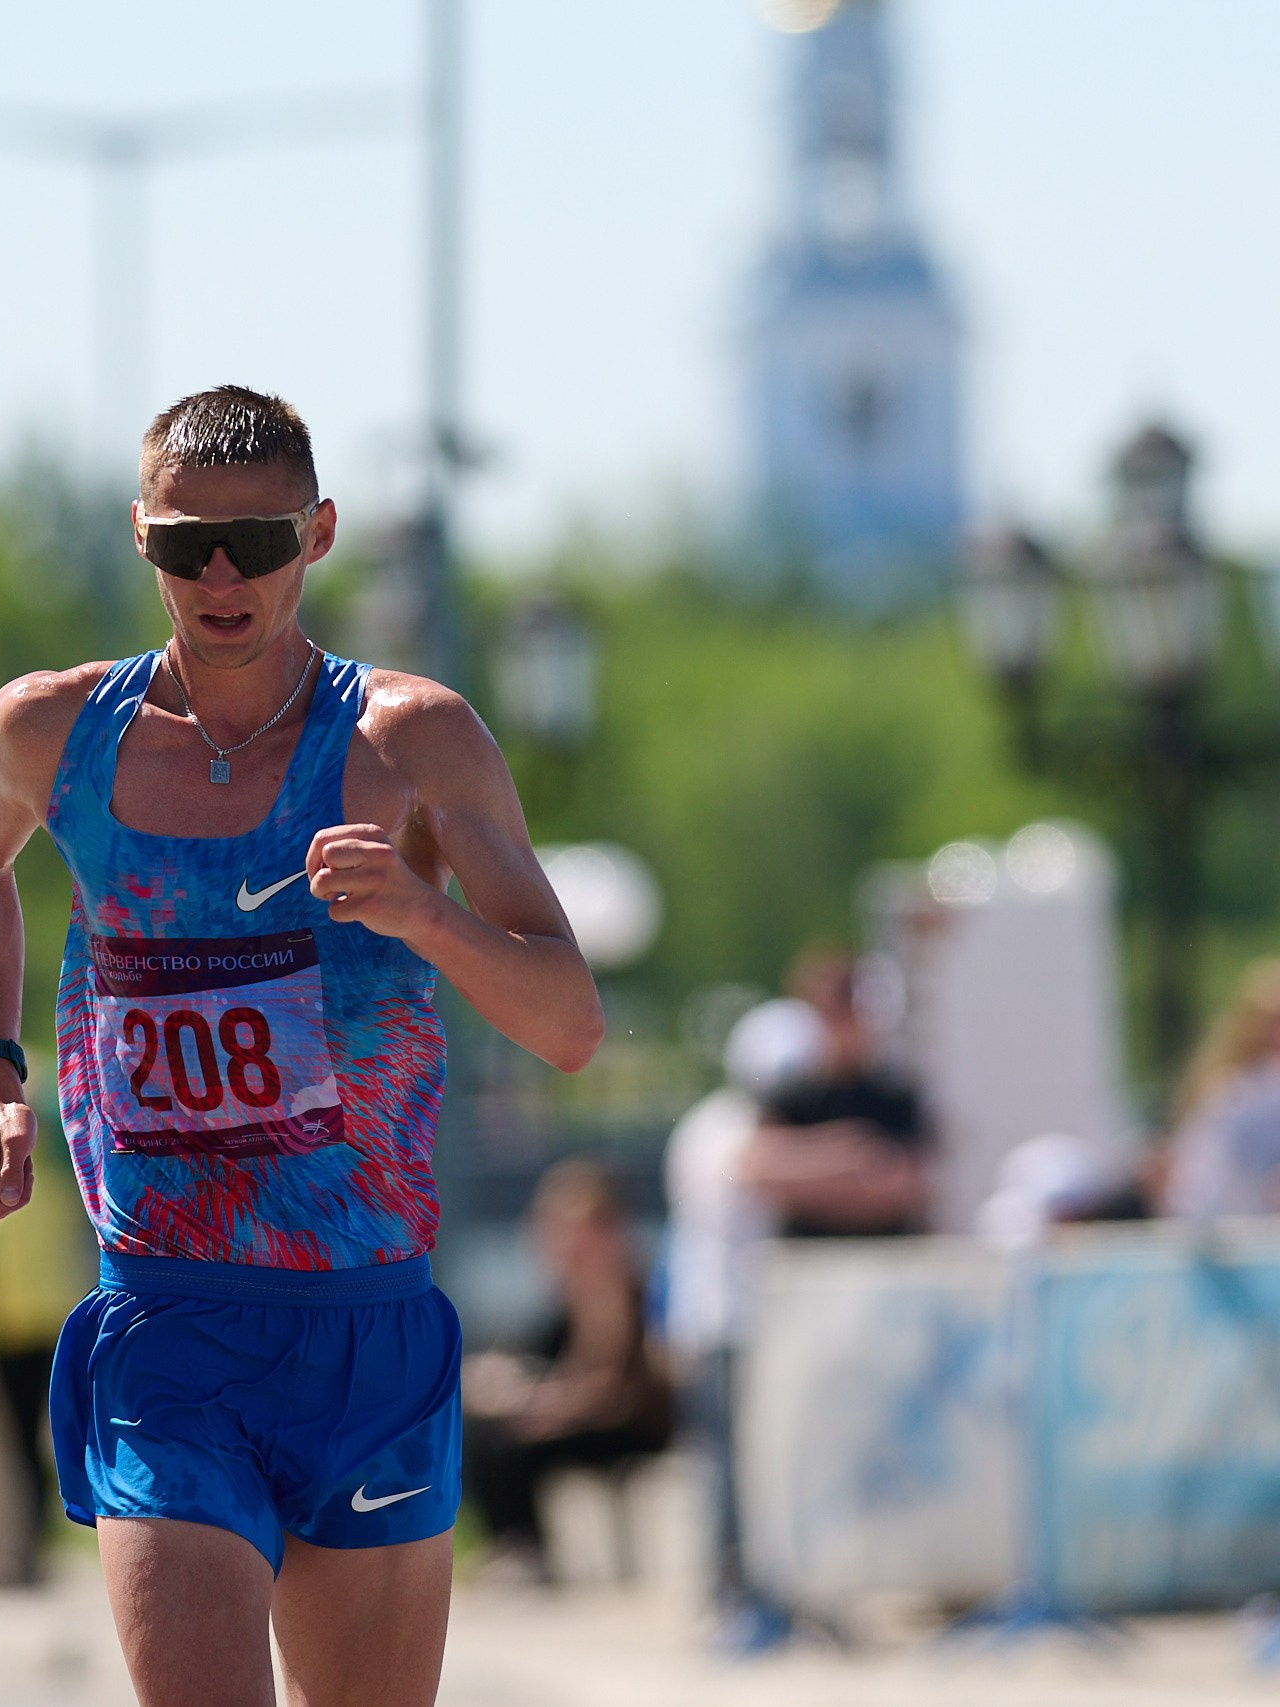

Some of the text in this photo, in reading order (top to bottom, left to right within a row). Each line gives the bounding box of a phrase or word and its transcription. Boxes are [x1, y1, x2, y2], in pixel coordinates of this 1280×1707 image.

[95, 949, 295, 971] ПЕРВЕНСТВО РОССИИ
[108, 970, 143, 983] ходьбе
[122, 1007, 282, 1112] 208
